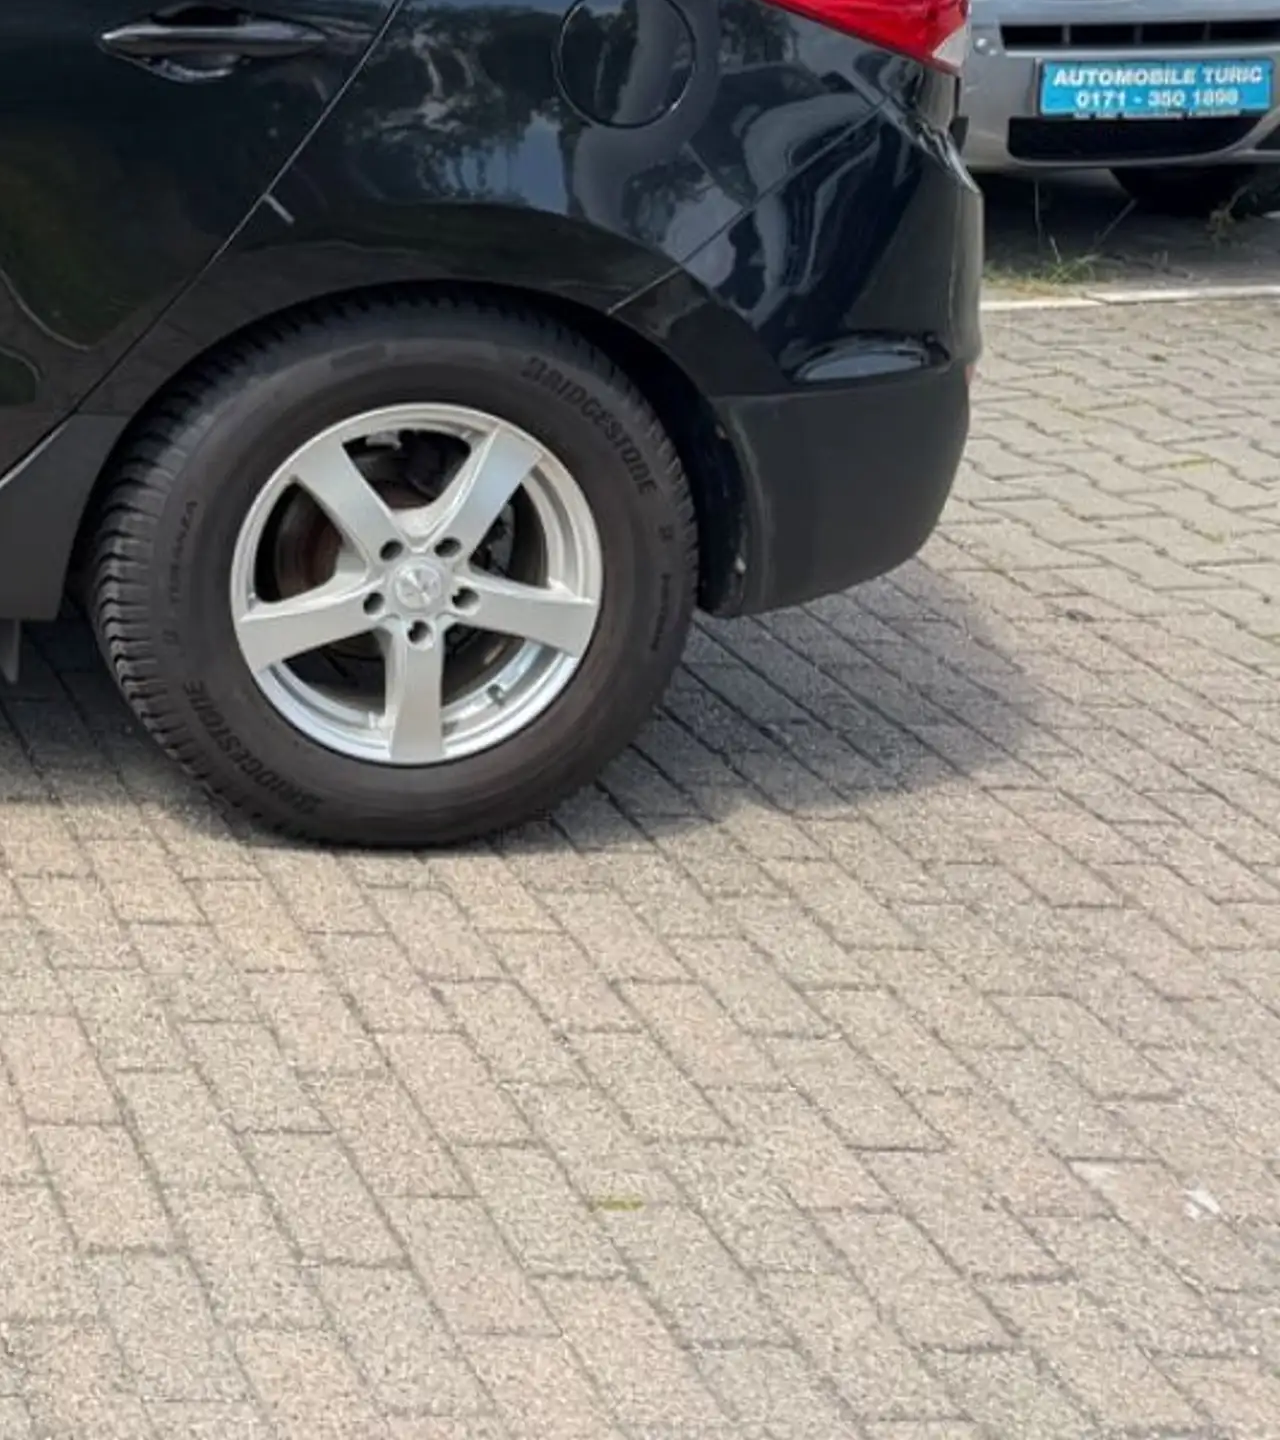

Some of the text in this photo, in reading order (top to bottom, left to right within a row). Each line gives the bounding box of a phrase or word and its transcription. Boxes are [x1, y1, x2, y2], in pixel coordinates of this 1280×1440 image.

[1053, 67, 1197, 87] AUTOMOBILE
[1075, 89, 1127, 109] 0171
[519, 356, 658, 497] BRIDGESTONE
